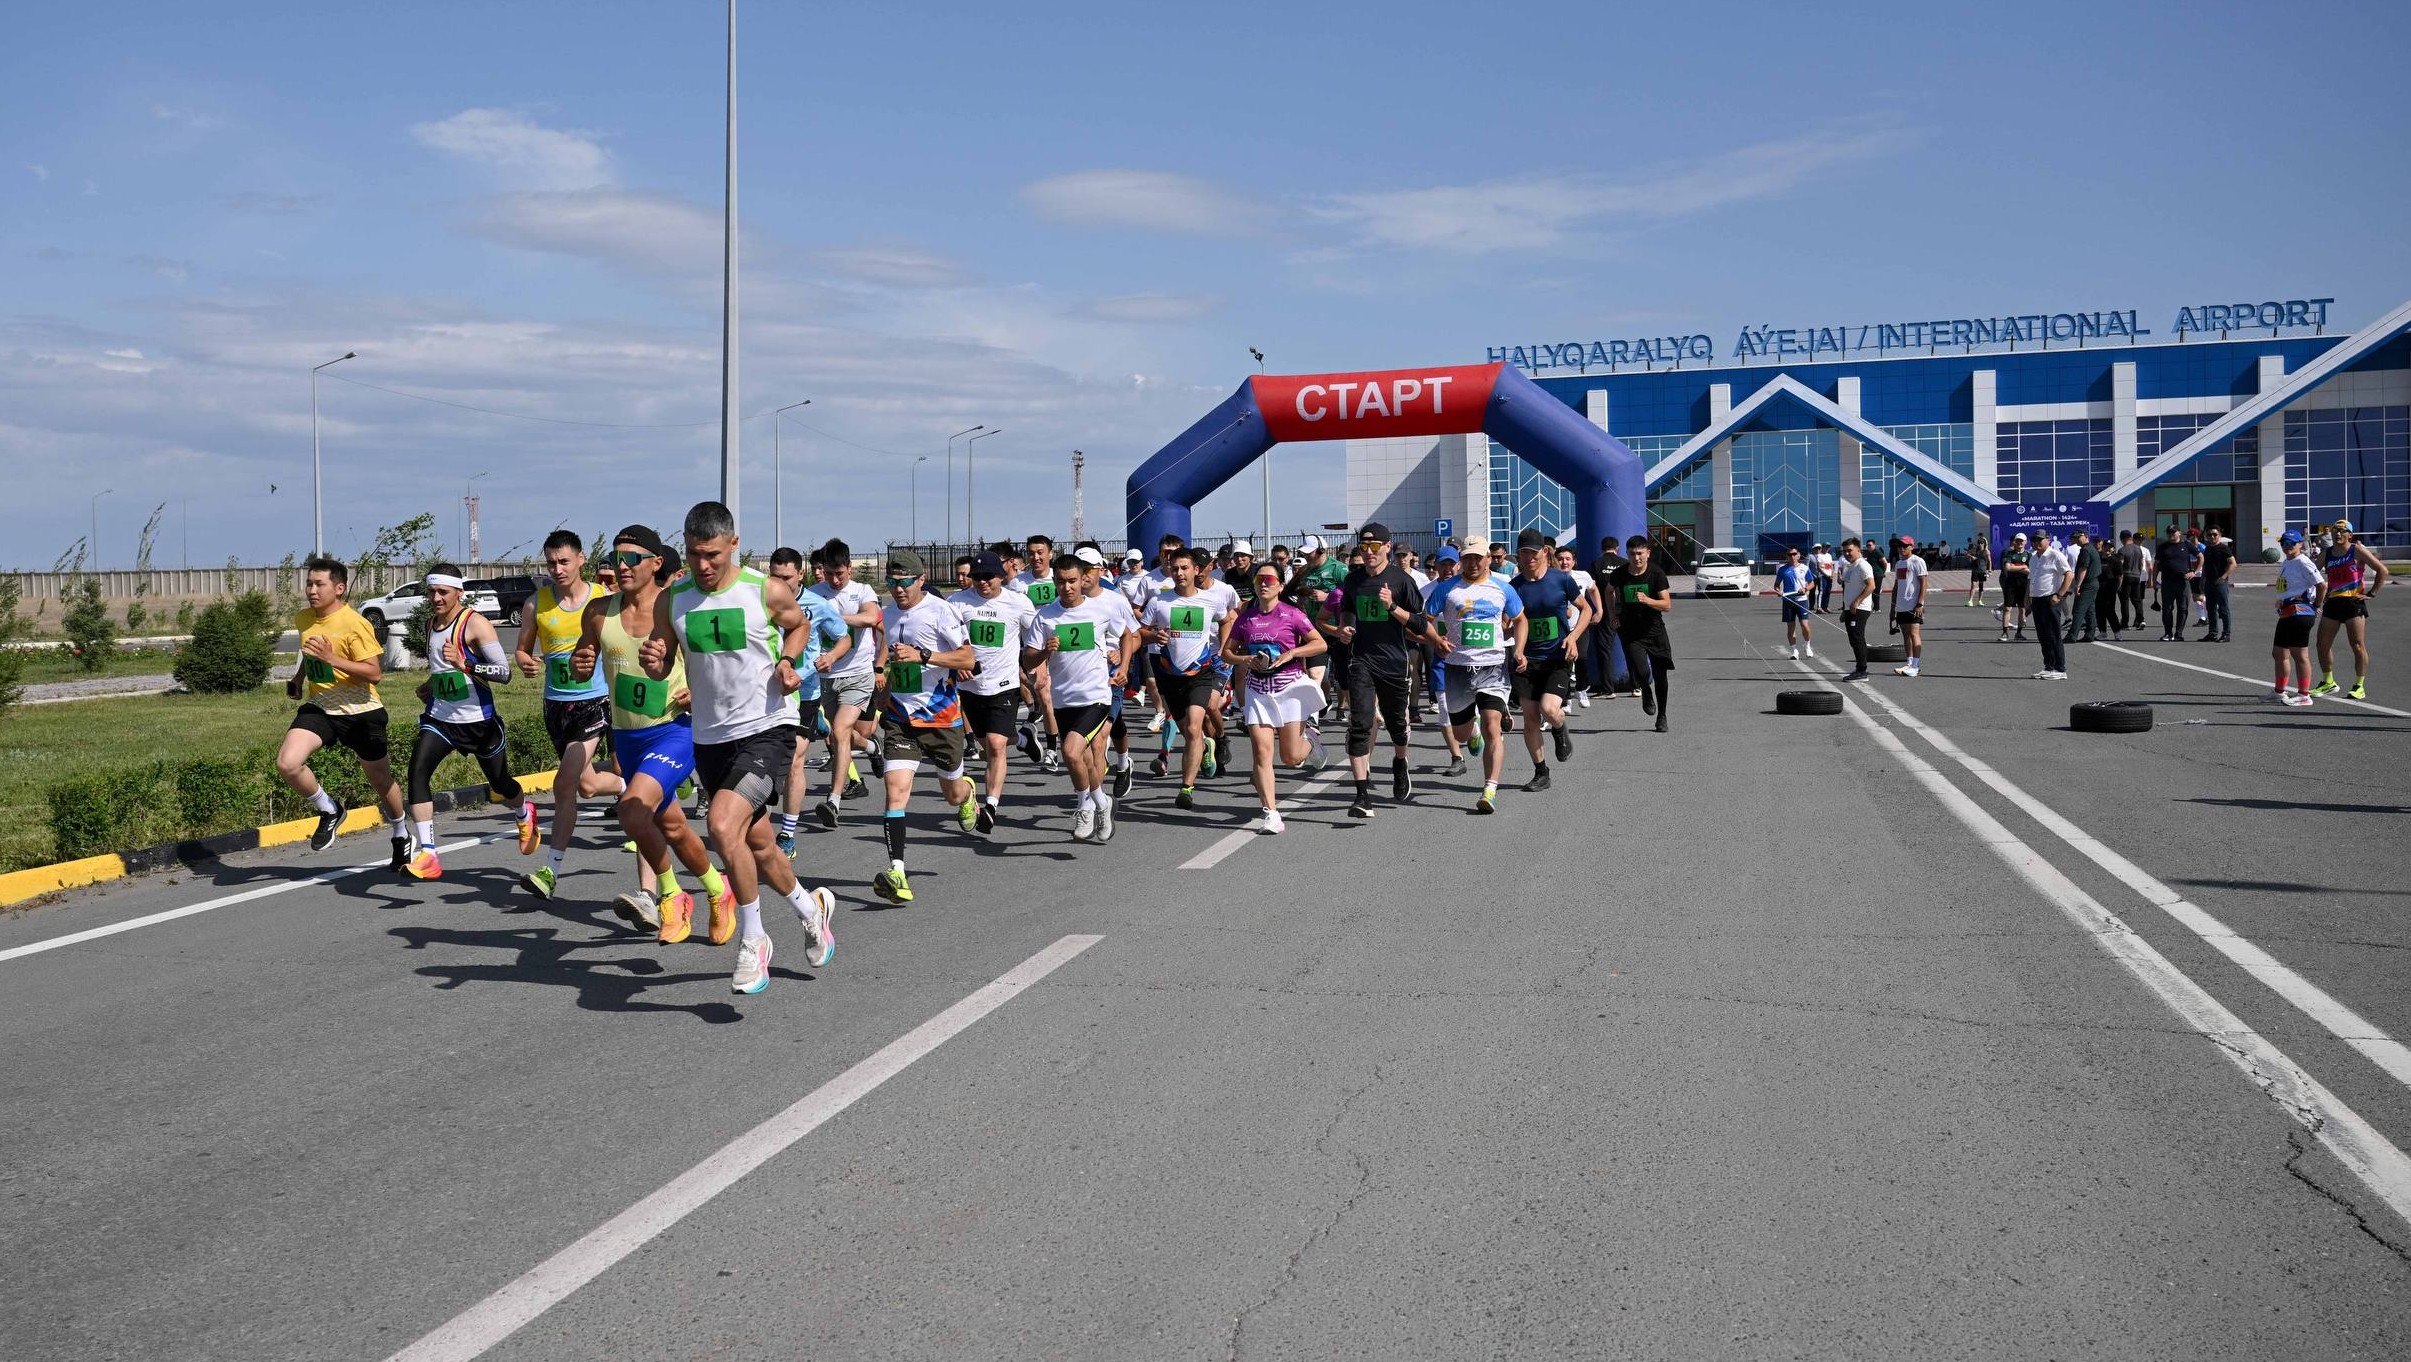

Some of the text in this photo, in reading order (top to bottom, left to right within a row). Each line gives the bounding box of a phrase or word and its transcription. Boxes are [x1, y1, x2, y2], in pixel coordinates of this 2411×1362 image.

[1486, 335, 1713, 370] HALYQARALYQ
[1878, 310, 2150, 350] INTERNATIONAL
[2171, 298, 2335, 334] AIRPORT
[1296, 376, 1453, 421] СТАРТ
[1438, 521, 1448, 535] P
[1036, 586, 1050, 600] 13
[1364, 600, 1378, 618] 15
[1183, 611, 1192, 627] 4
[710, 616, 720, 645] 1
[979, 625, 995, 643] 18
[1070, 627, 1080, 646] 2
[1465, 628, 1490, 640] 256
[437, 677, 458, 698] 44
[633, 682, 646, 708] 9
